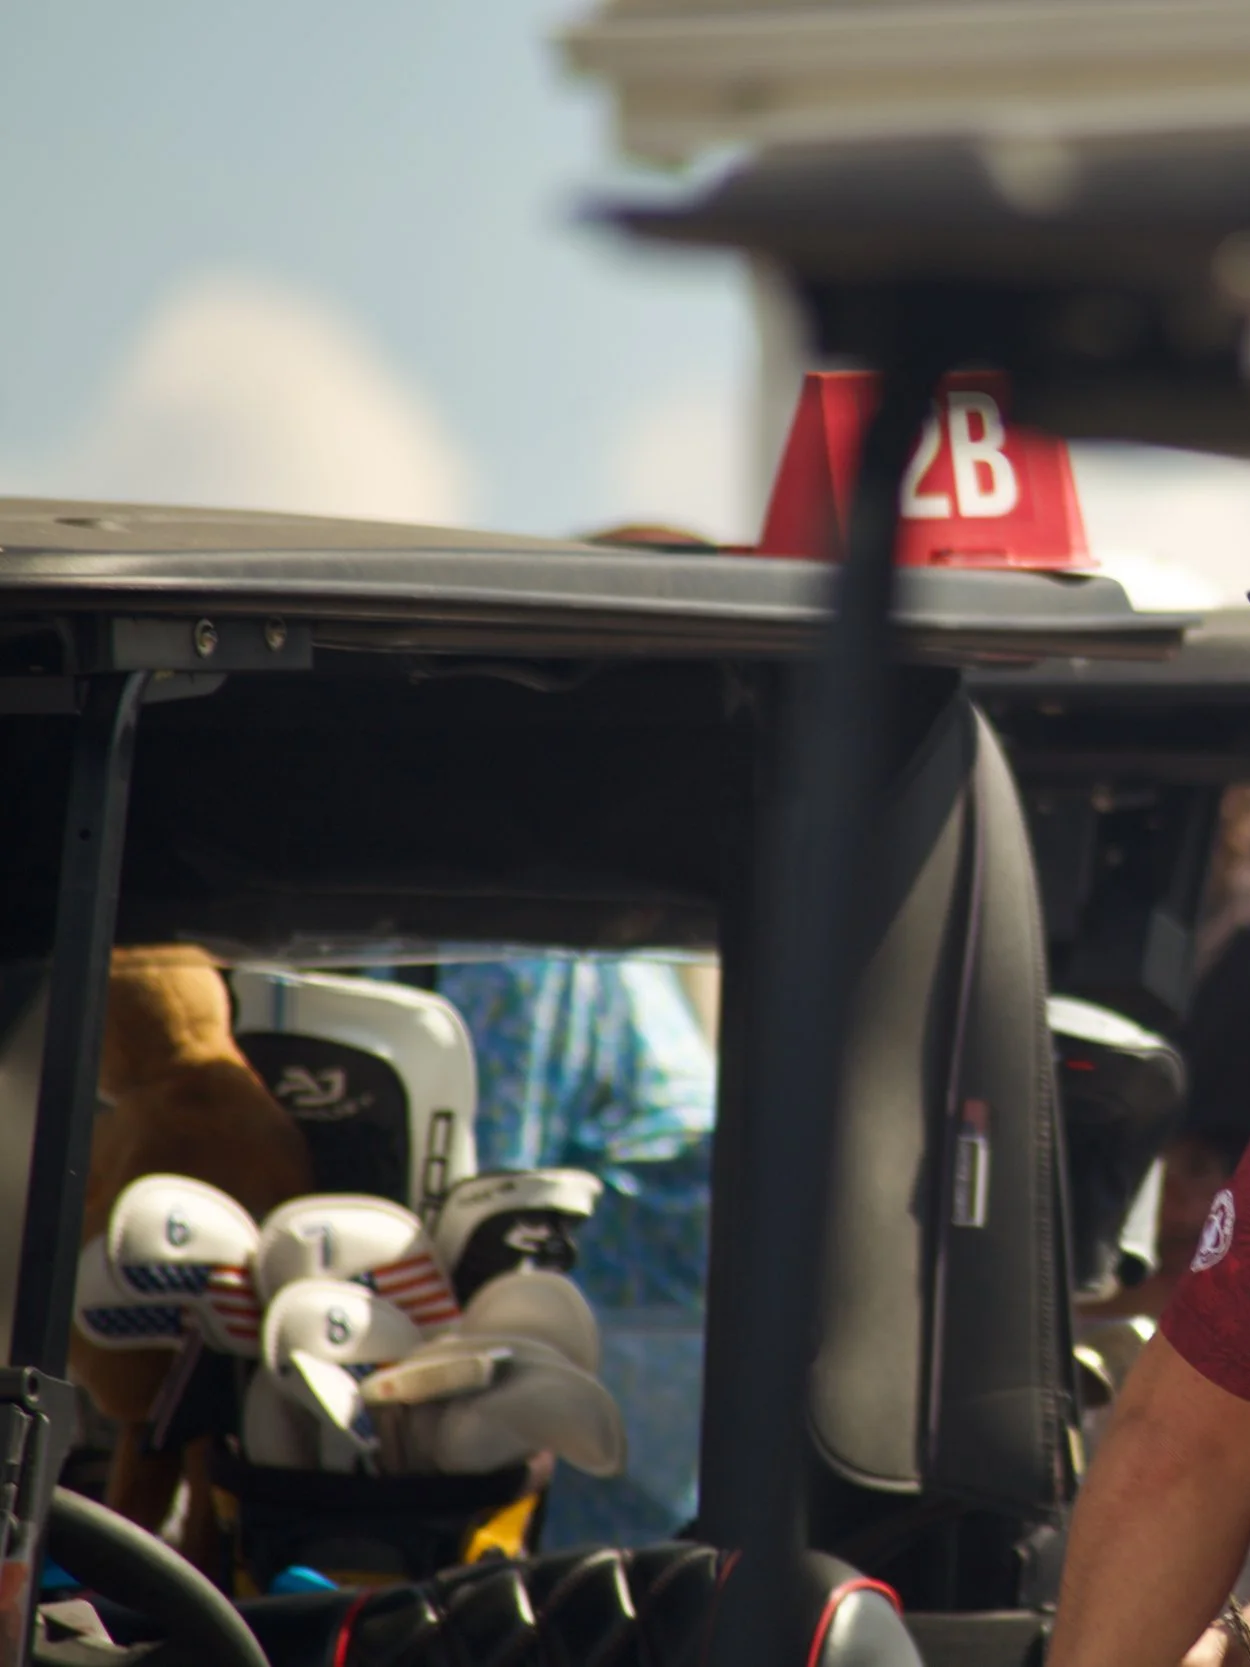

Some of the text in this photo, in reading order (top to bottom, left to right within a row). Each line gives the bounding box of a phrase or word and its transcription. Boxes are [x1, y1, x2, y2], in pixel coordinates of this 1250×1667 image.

[900, 391, 1018, 518] 2B
[166, 1207, 191, 1248] 6
[326, 1306, 352, 1345] 8
